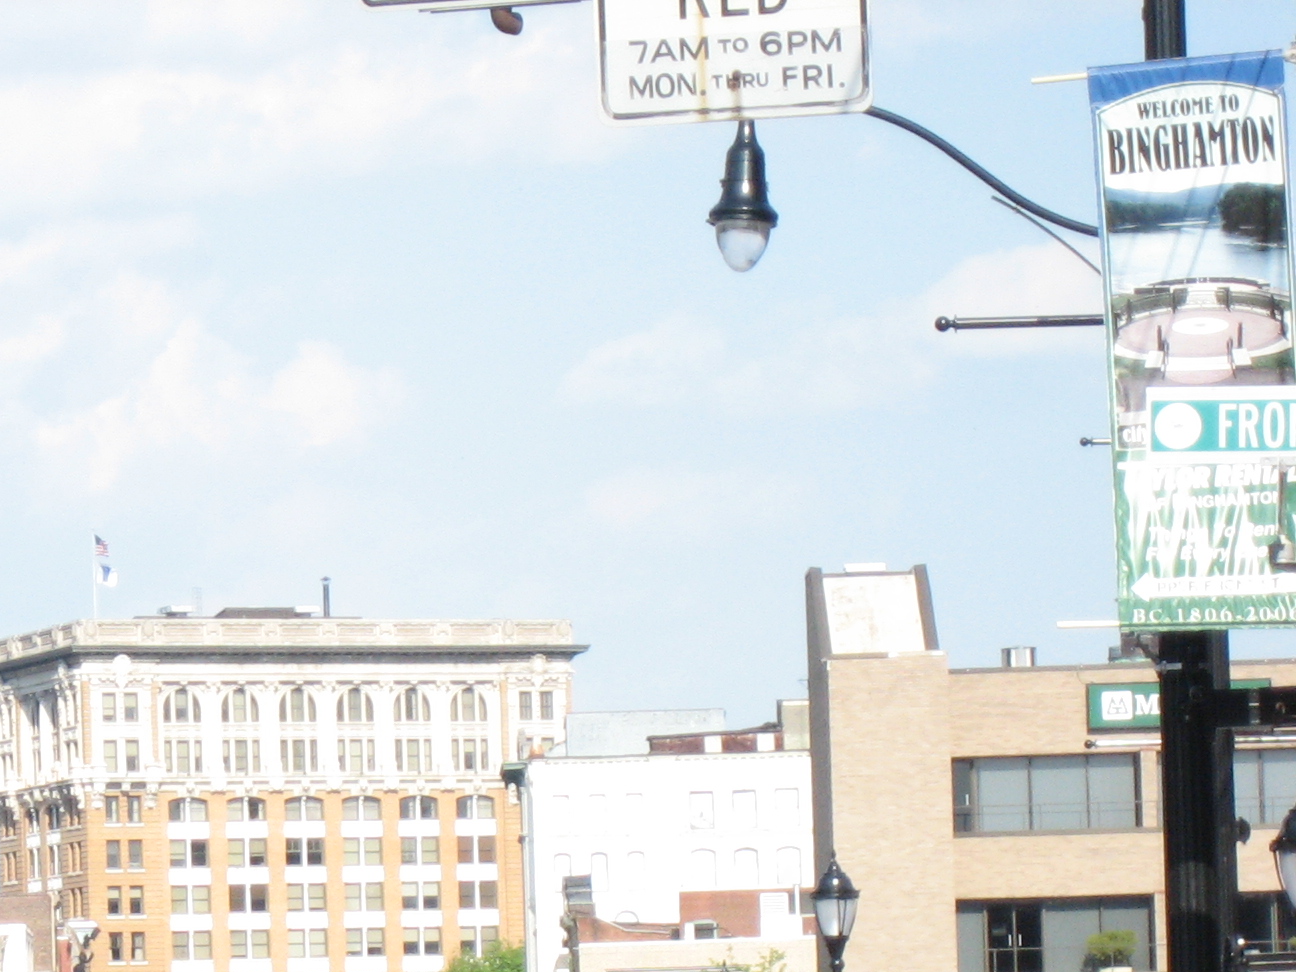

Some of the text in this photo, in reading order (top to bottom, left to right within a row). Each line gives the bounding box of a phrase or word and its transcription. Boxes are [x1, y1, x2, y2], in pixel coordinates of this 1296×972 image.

[628, 27, 842, 65] 7AM TO 6PM
[1136, 93, 1241, 120] WELCOME TO
[1107, 114, 1277, 176] BINGHAMTON
